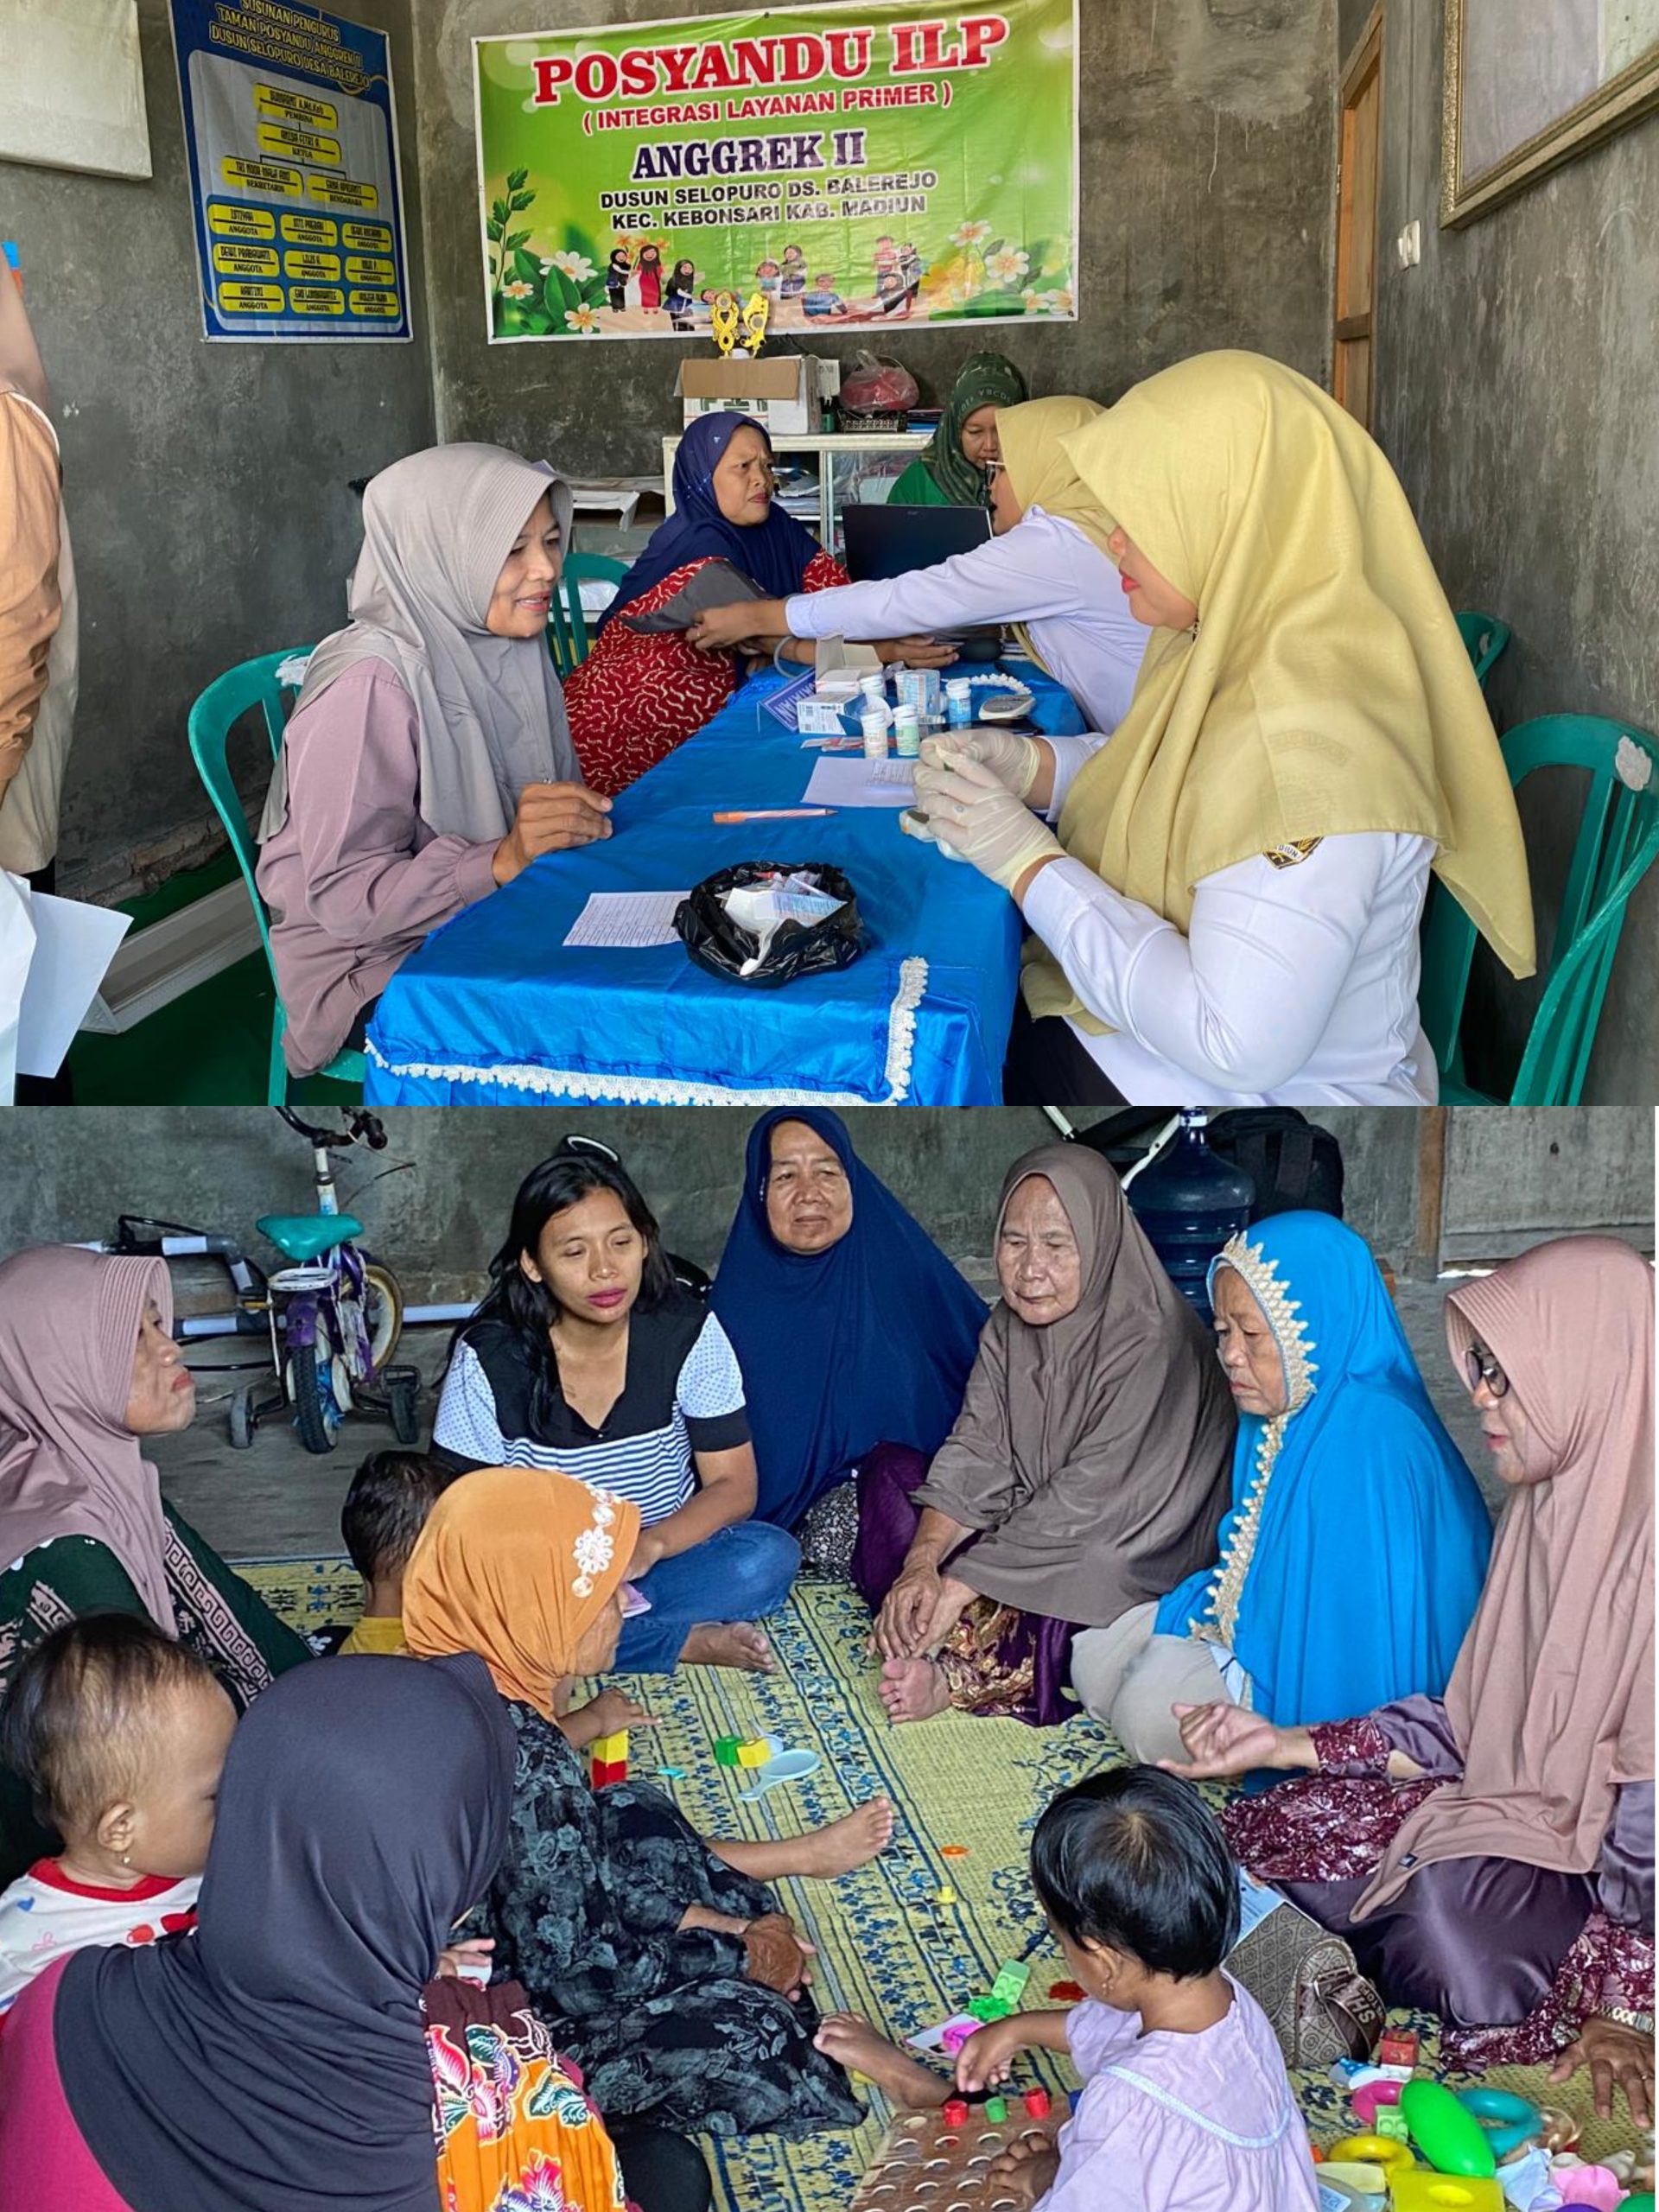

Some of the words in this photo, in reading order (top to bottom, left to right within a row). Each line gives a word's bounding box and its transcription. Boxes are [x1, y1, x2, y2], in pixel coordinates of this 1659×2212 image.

[241, 0, 291, 24] SUSUNAN
[293, 13, 340, 41] PENGURUS
[218, 7, 257, 32] TAMAN
[259, 22, 312, 50] POSYANDU
[212, 25, 248, 48] DUSUN
[250, 39, 302, 66] SELOPURO
[304, 54, 327, 75] DESA
[328, 63, 370, 87] BALEREJO
[533, 30, 872, 103] POSYANDU
[892, 18, 1006, 73] ILP
[598, 103, 719, 129] INTEGRASI
[728, 92, 835, 119] LAYANAN
[843, 84, 936, 111] PRIMER
[284, 110, 314, 125] PEMBINA
[292, 146, 313, 159] KETUA
[632, 134, 824, 180] ANGGREK
[833, 130, 865, 166] II
[246, 179, 285, 194] SEKRETARIS
[601, 189, 669, 209] DUSUN
[675, 182, 781, 204] SELOPURO
[788, 181, 821, 197] DS.
[827, 172, 937, 194] BALEREJO
[329, 194, 363, 207] BENDAHARA
[612, 213, 658, 230] KEC.
[664, 206, 780, 227] KEBONSARI
[786, 202, 835, 220] KAB.
[842, 195, 925, 217] MADIUN
[229, 225, 258, 236] ANGGOTA
[297, 232, 323, 244] ANGGOTA
[357, 240, 379, 250] ANGGOTA
[233, 264, 263, 274] ANGGOTA
[301, 269, 327, 279] ANGGOTA
[359, 274, 383, 283] ANGGOTA
[238, 302, 269, 310] ANGGOTA
[306, 303, 331, 313] ANGGOTA
[364, 305, 385, 314] ANGGOTA
